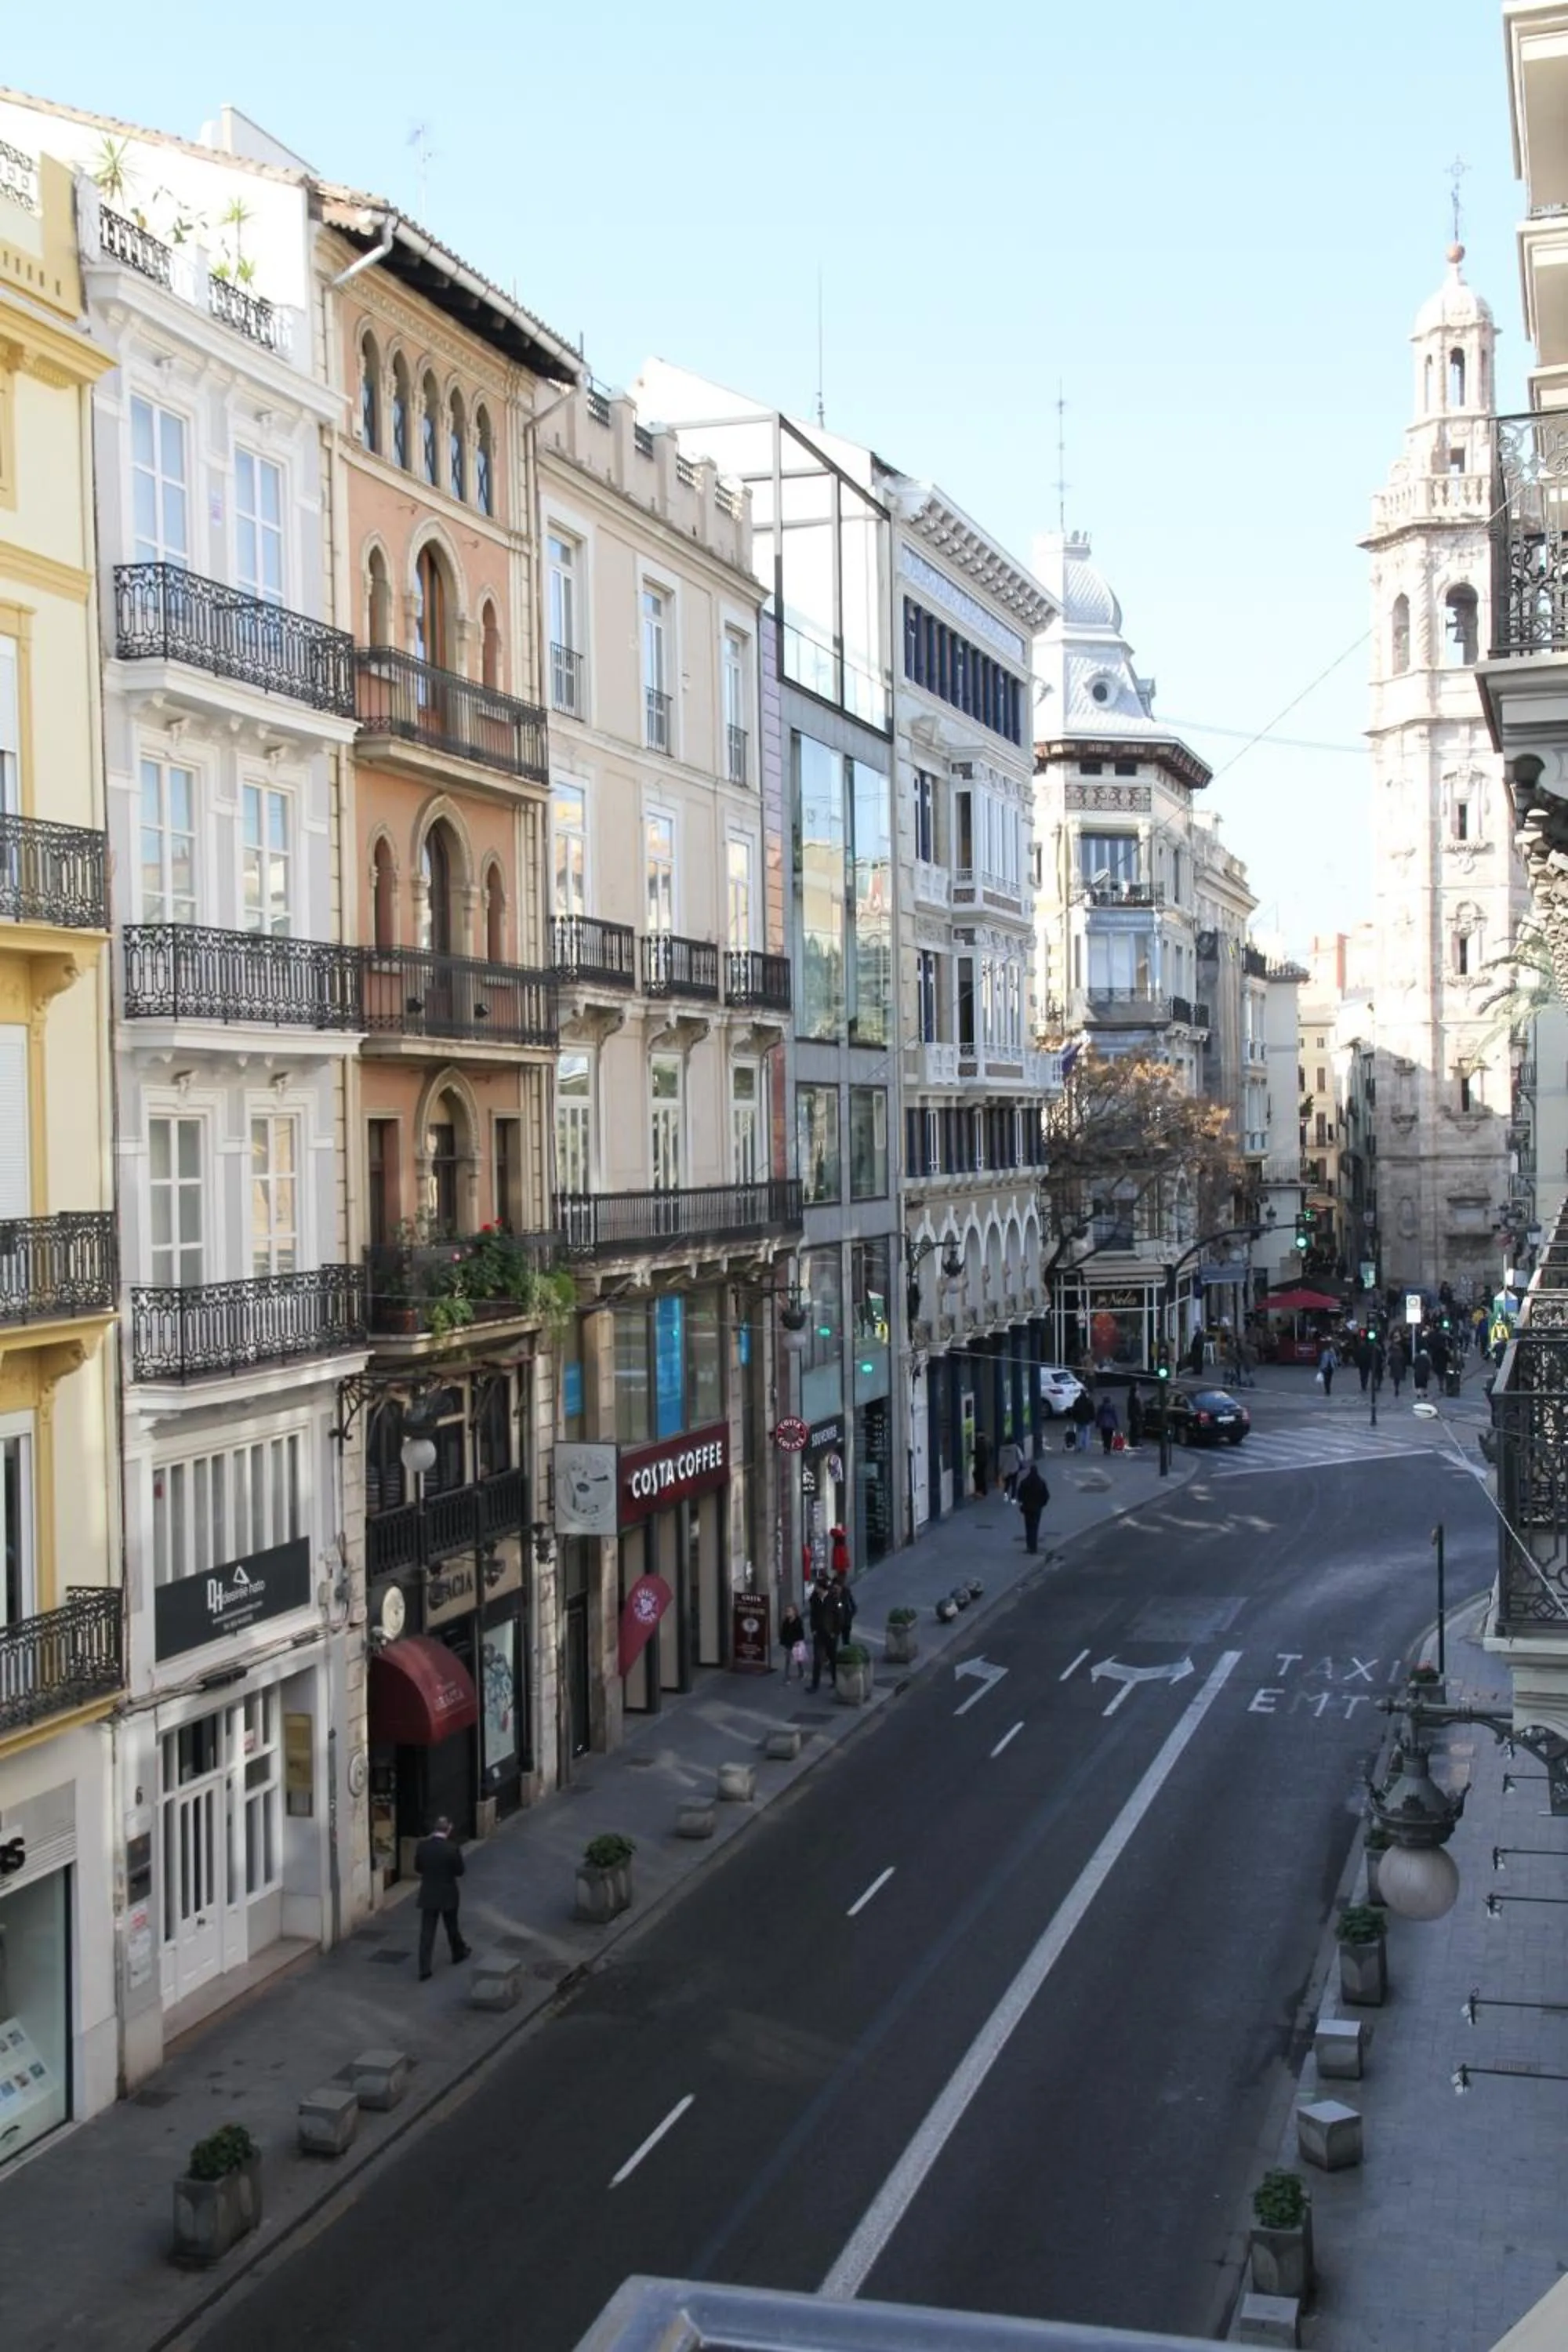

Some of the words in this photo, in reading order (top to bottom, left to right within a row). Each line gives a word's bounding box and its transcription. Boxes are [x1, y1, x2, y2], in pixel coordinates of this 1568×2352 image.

[631, 1458, 675, 1499] COSTA
[677, 1441, 723, 1481] COFFEE
[1276, 1653, 1402, 1683] TAXI
[1247, 1688, 1370, 1719] EMT
[135, 1785, 143, 1806] 6
